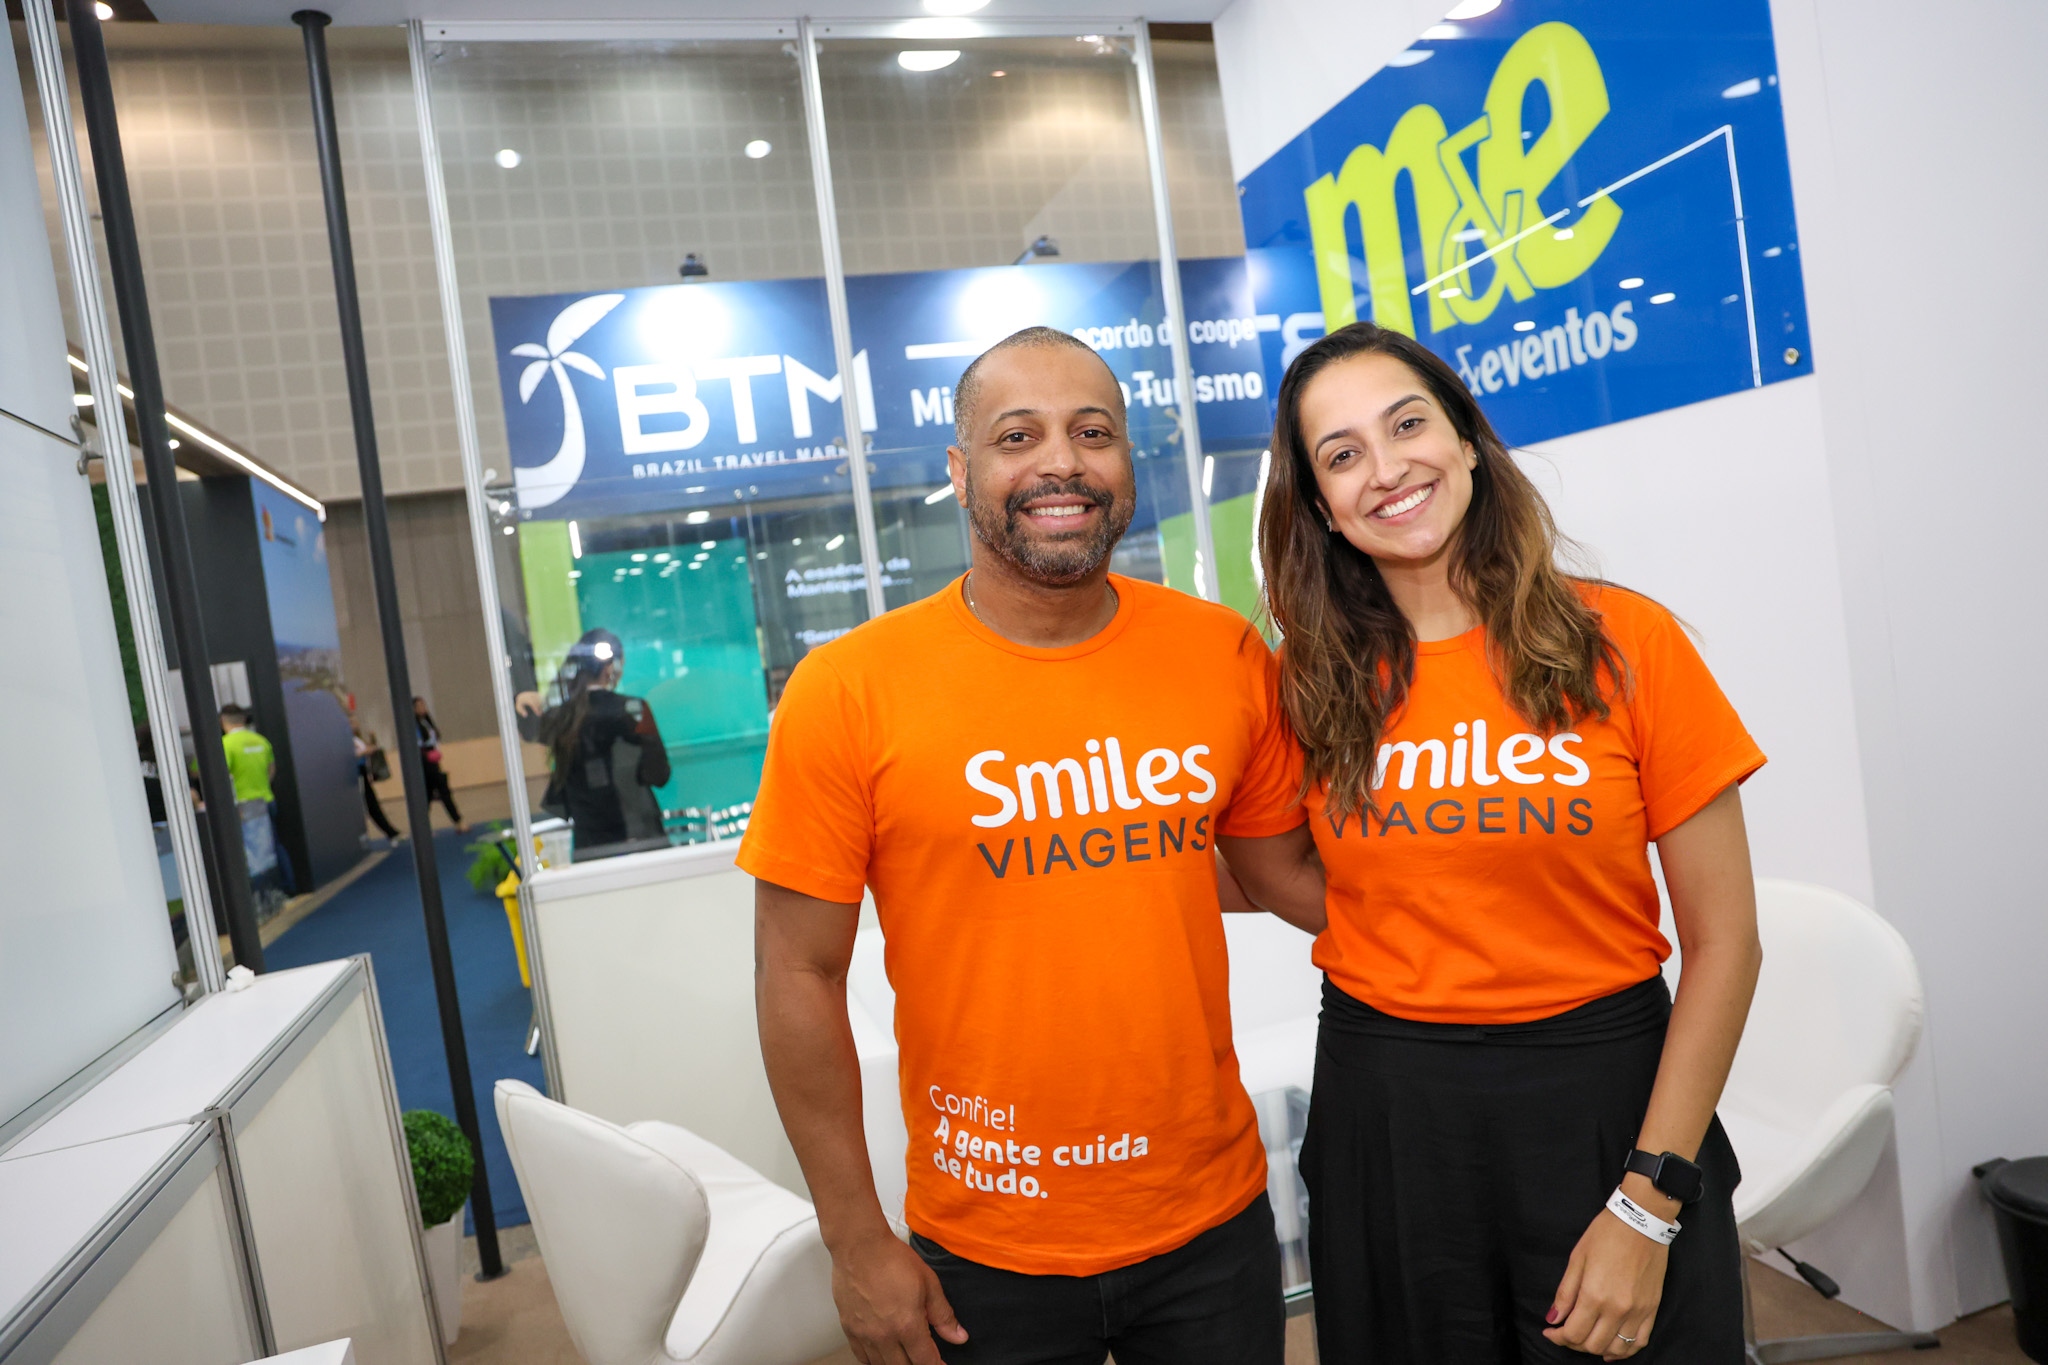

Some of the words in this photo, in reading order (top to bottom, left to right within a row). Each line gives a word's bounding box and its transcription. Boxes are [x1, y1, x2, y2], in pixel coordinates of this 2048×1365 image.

[613, 348, 878, 455] BTM
[632, 458, 703, 480] BRAZIL
[713, 449, 789, 471] TRAVEL
[965, 736, 1217, 828] Smiles
[1371, 719, 1590, 790] miles
[976, 814, 1210, 878] VIAGENS
[929, 1084, 1015, 1132] Confie!
[933, 1115, 950, 1145] A
[954, 1130, 1041, 1166] gente
[1052, 1133, 1149, 1167] cuida
[965, 1160, 1048, 1199] tudo.
